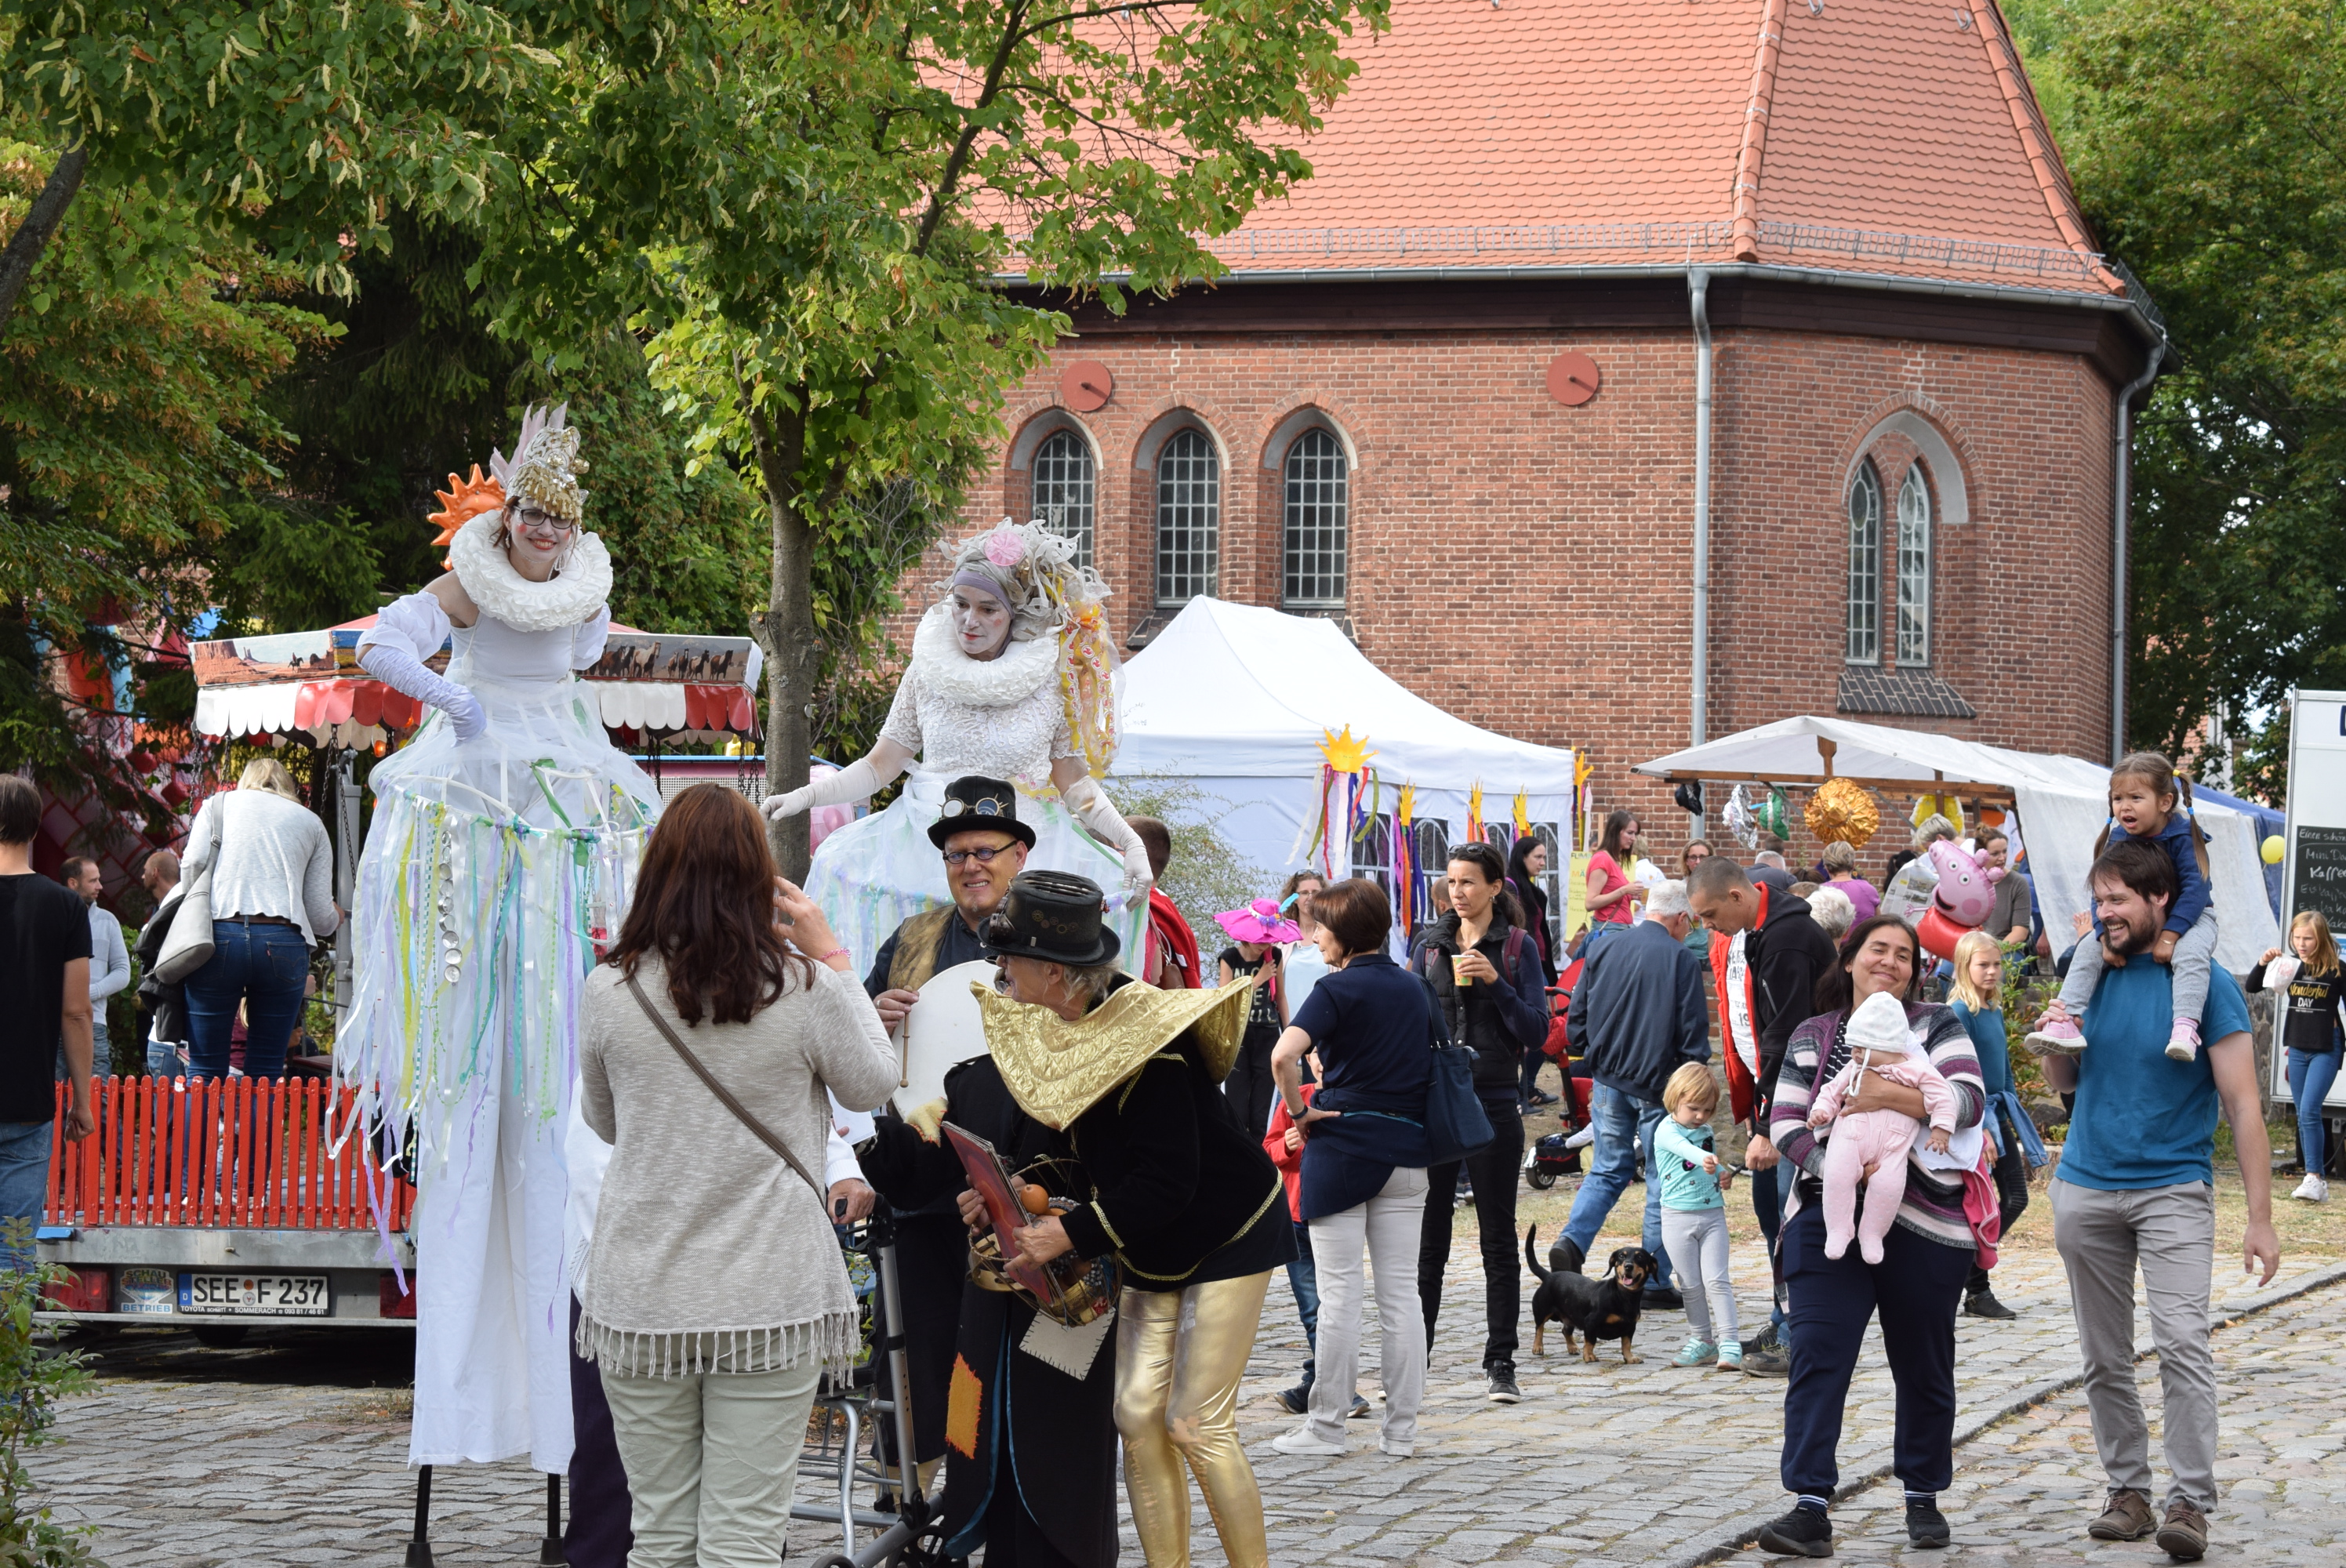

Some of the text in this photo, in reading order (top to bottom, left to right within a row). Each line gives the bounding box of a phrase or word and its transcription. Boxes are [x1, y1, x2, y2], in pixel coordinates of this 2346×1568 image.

[2305, 848, 2329, 860] Mini
[2297, 997, 2314, 1007] DAY
[126, 1269, 167, 1279] SCHAU
[122, 1276, 172, 1286] STELLER
[183, 1293, 188, 1301] D
[194, 1277, 241, 1303] SEE
[257, 1279, 273, 1304] F
[278, 1279, 325, 1305] 237
[123, 1304, 171, 1312] BETRIEB
